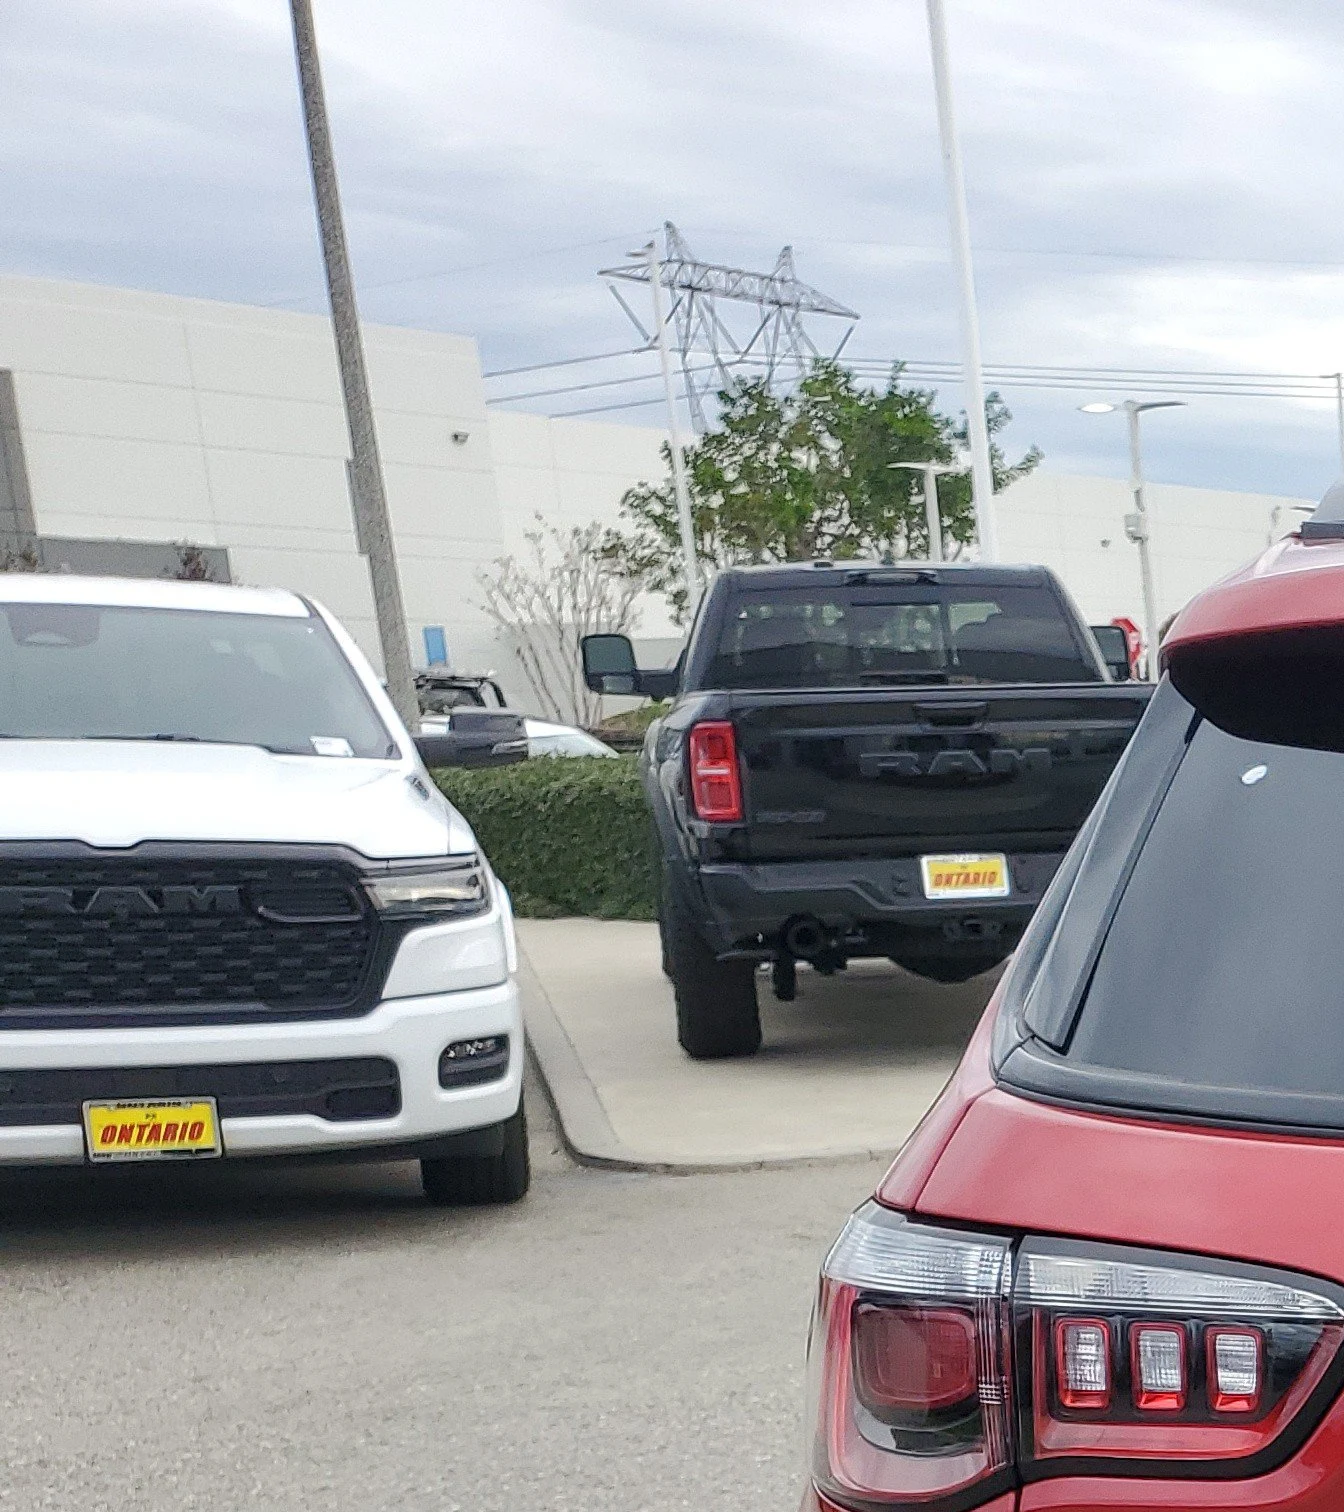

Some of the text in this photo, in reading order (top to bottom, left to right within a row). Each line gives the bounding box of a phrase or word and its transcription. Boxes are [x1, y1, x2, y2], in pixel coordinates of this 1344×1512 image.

[859, 747, 1050, 778] RAM
[934, 871, 998, 887] ONTARIO
[0, 885, 243, 914] RAM
[100, 1120, 206, 1146] ONTARIO
